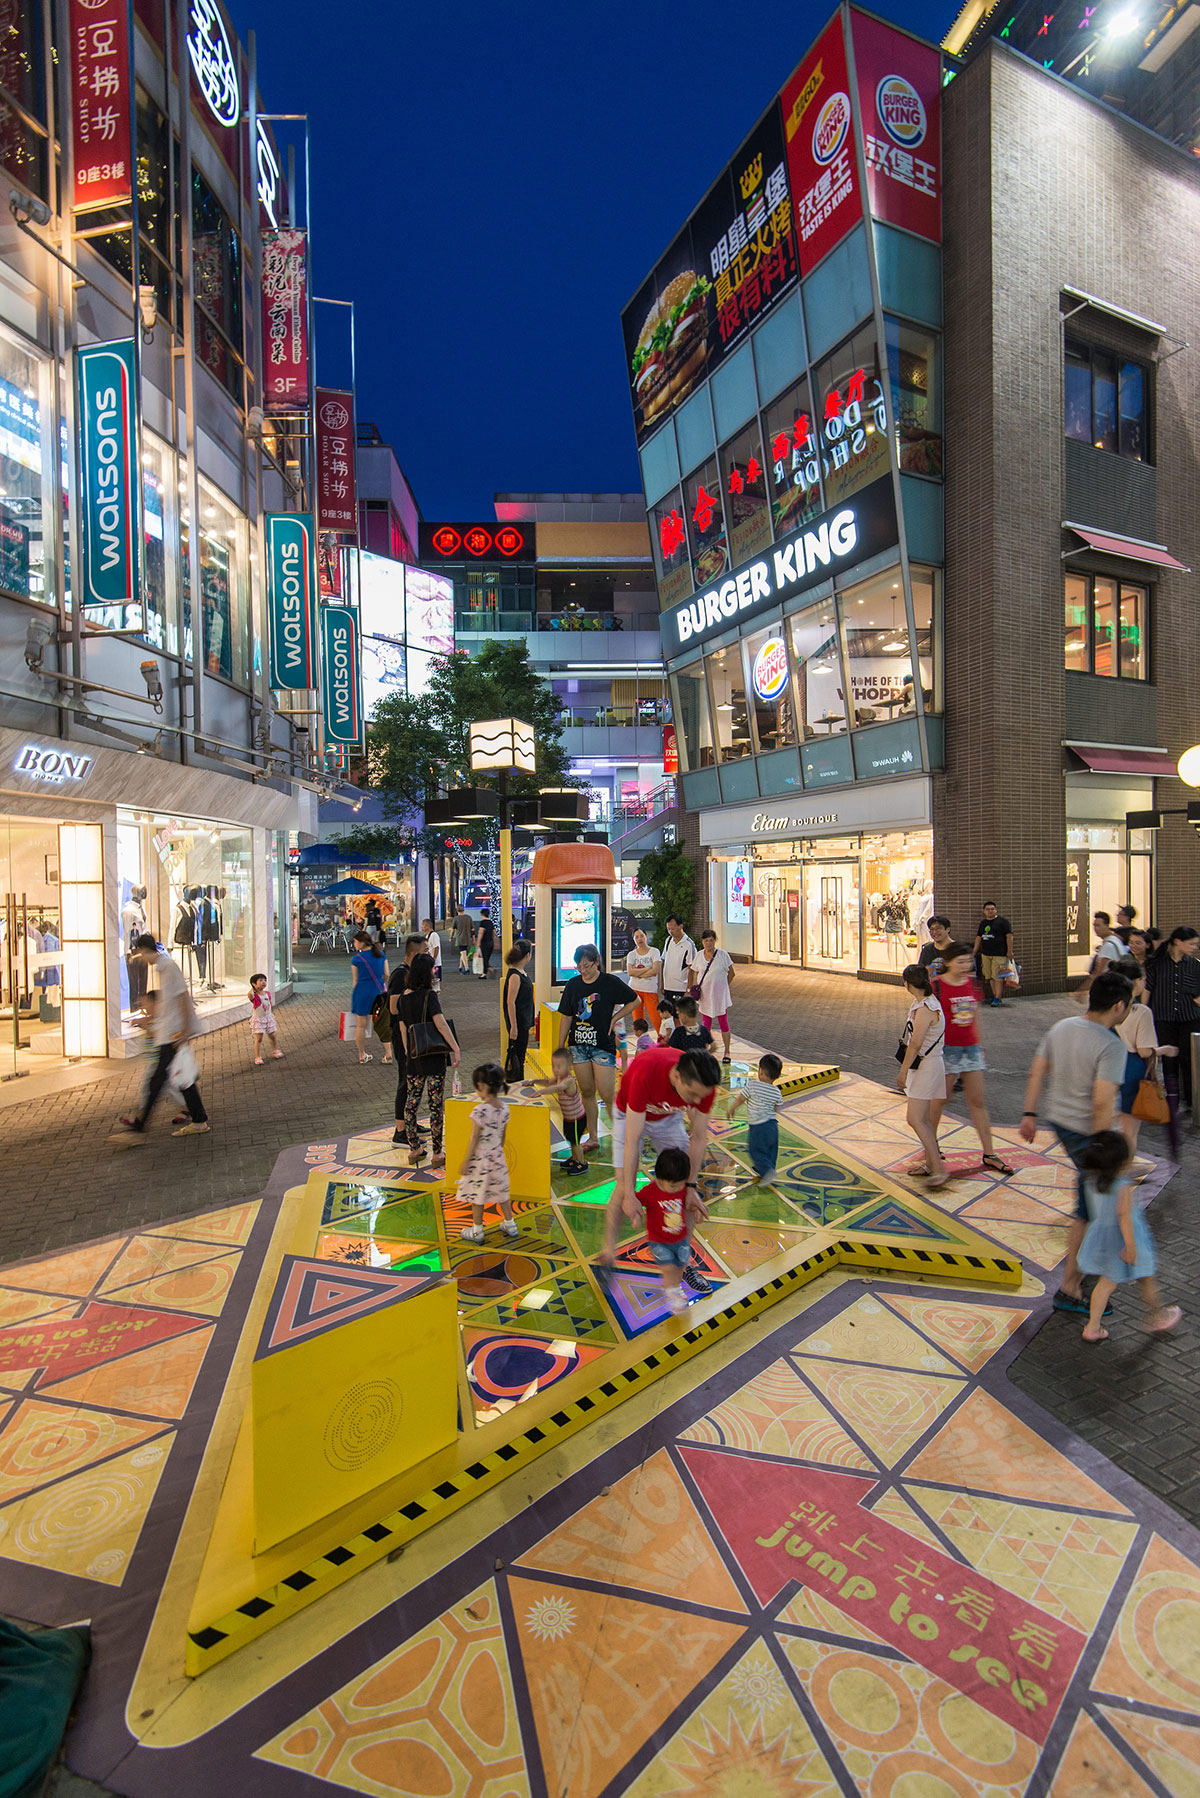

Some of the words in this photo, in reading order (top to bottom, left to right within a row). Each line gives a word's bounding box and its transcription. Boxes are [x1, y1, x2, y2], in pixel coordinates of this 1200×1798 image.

[77, 27, 88, 86] DOLAR
[88, 19, 120, 140] 豆捞坊
[79, 98, 90, 143] SHOP
[818, 98, 842, 146] BURGER
[883, 93, 919, 110] BURGER
[885, 106, 921, 125] KING
[819, 108, 846, 157] KING
[799, 148, 851, 227] 汉堡王
[866, 134, 937, 198] 汉堡王
[801, 213, 824, 242] TASTE
[824, 204, 833, 218] IS
[832, 177, 853, 212] KING
[714, 195, 791, 312] 真正火烤
[274, 377, 297, 393] 3F
[96, 386, 120, 572] watsons
[329, 437, 348, 498] 豆捞坊
[676, 561, 771, 642] BURGER
[773, 510, 857, 587] KING
[281, 542, 299, 669] watsons
[333, 627, 349, 724] watsons
[757, 645, 785, 677] BURGER
[759, 655, 787, 690] KING
[880, 676, 892, 686] OF
[17, 747, 91, 778] BONI
[751, 813, 790, 832] Etam
[792, 814, 838, 827] BOUTIQUE
[731, 893, 744, 902] SAL
[575, 1031, 597, 1040] FROOT
[53, 1328, 88, 1340] on
[97, 1317, 158, 1334] step
[789, 1501, 1060, 1671] 跳上去看看
[755, 1521, 877, 1600] jump
[889, 1592, 940, 1641] to
[948, 1645, 1048, 1711] see
